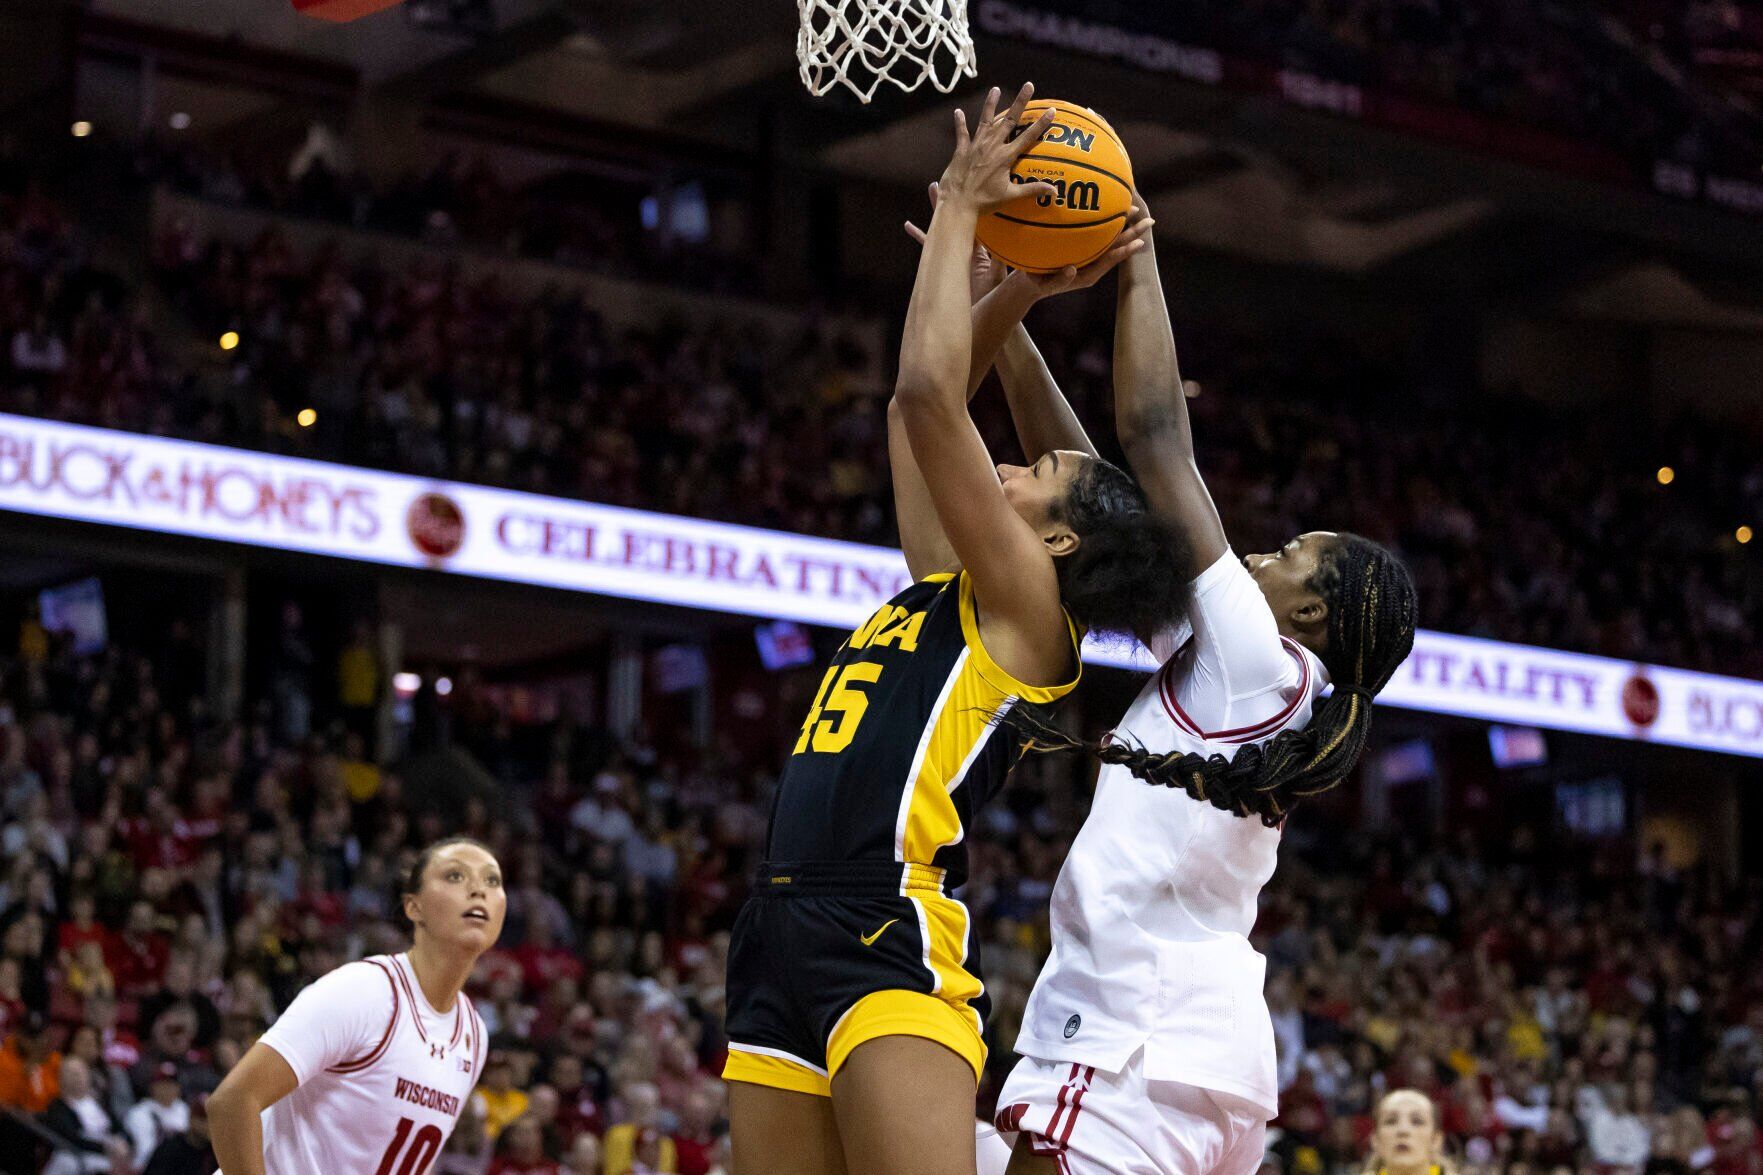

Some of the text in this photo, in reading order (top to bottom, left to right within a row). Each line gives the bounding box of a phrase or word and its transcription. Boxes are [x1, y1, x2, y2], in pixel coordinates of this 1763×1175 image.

[1004, 121, 1096, 153] NC
[1026, 167, 1046, 175] NXT
[838, 603, 928, 653] WA
[1408, 648, 1597, 711] ITALITY
[792, 661, 884, 756] 45
[376, 1116, 443, 1175] 10
